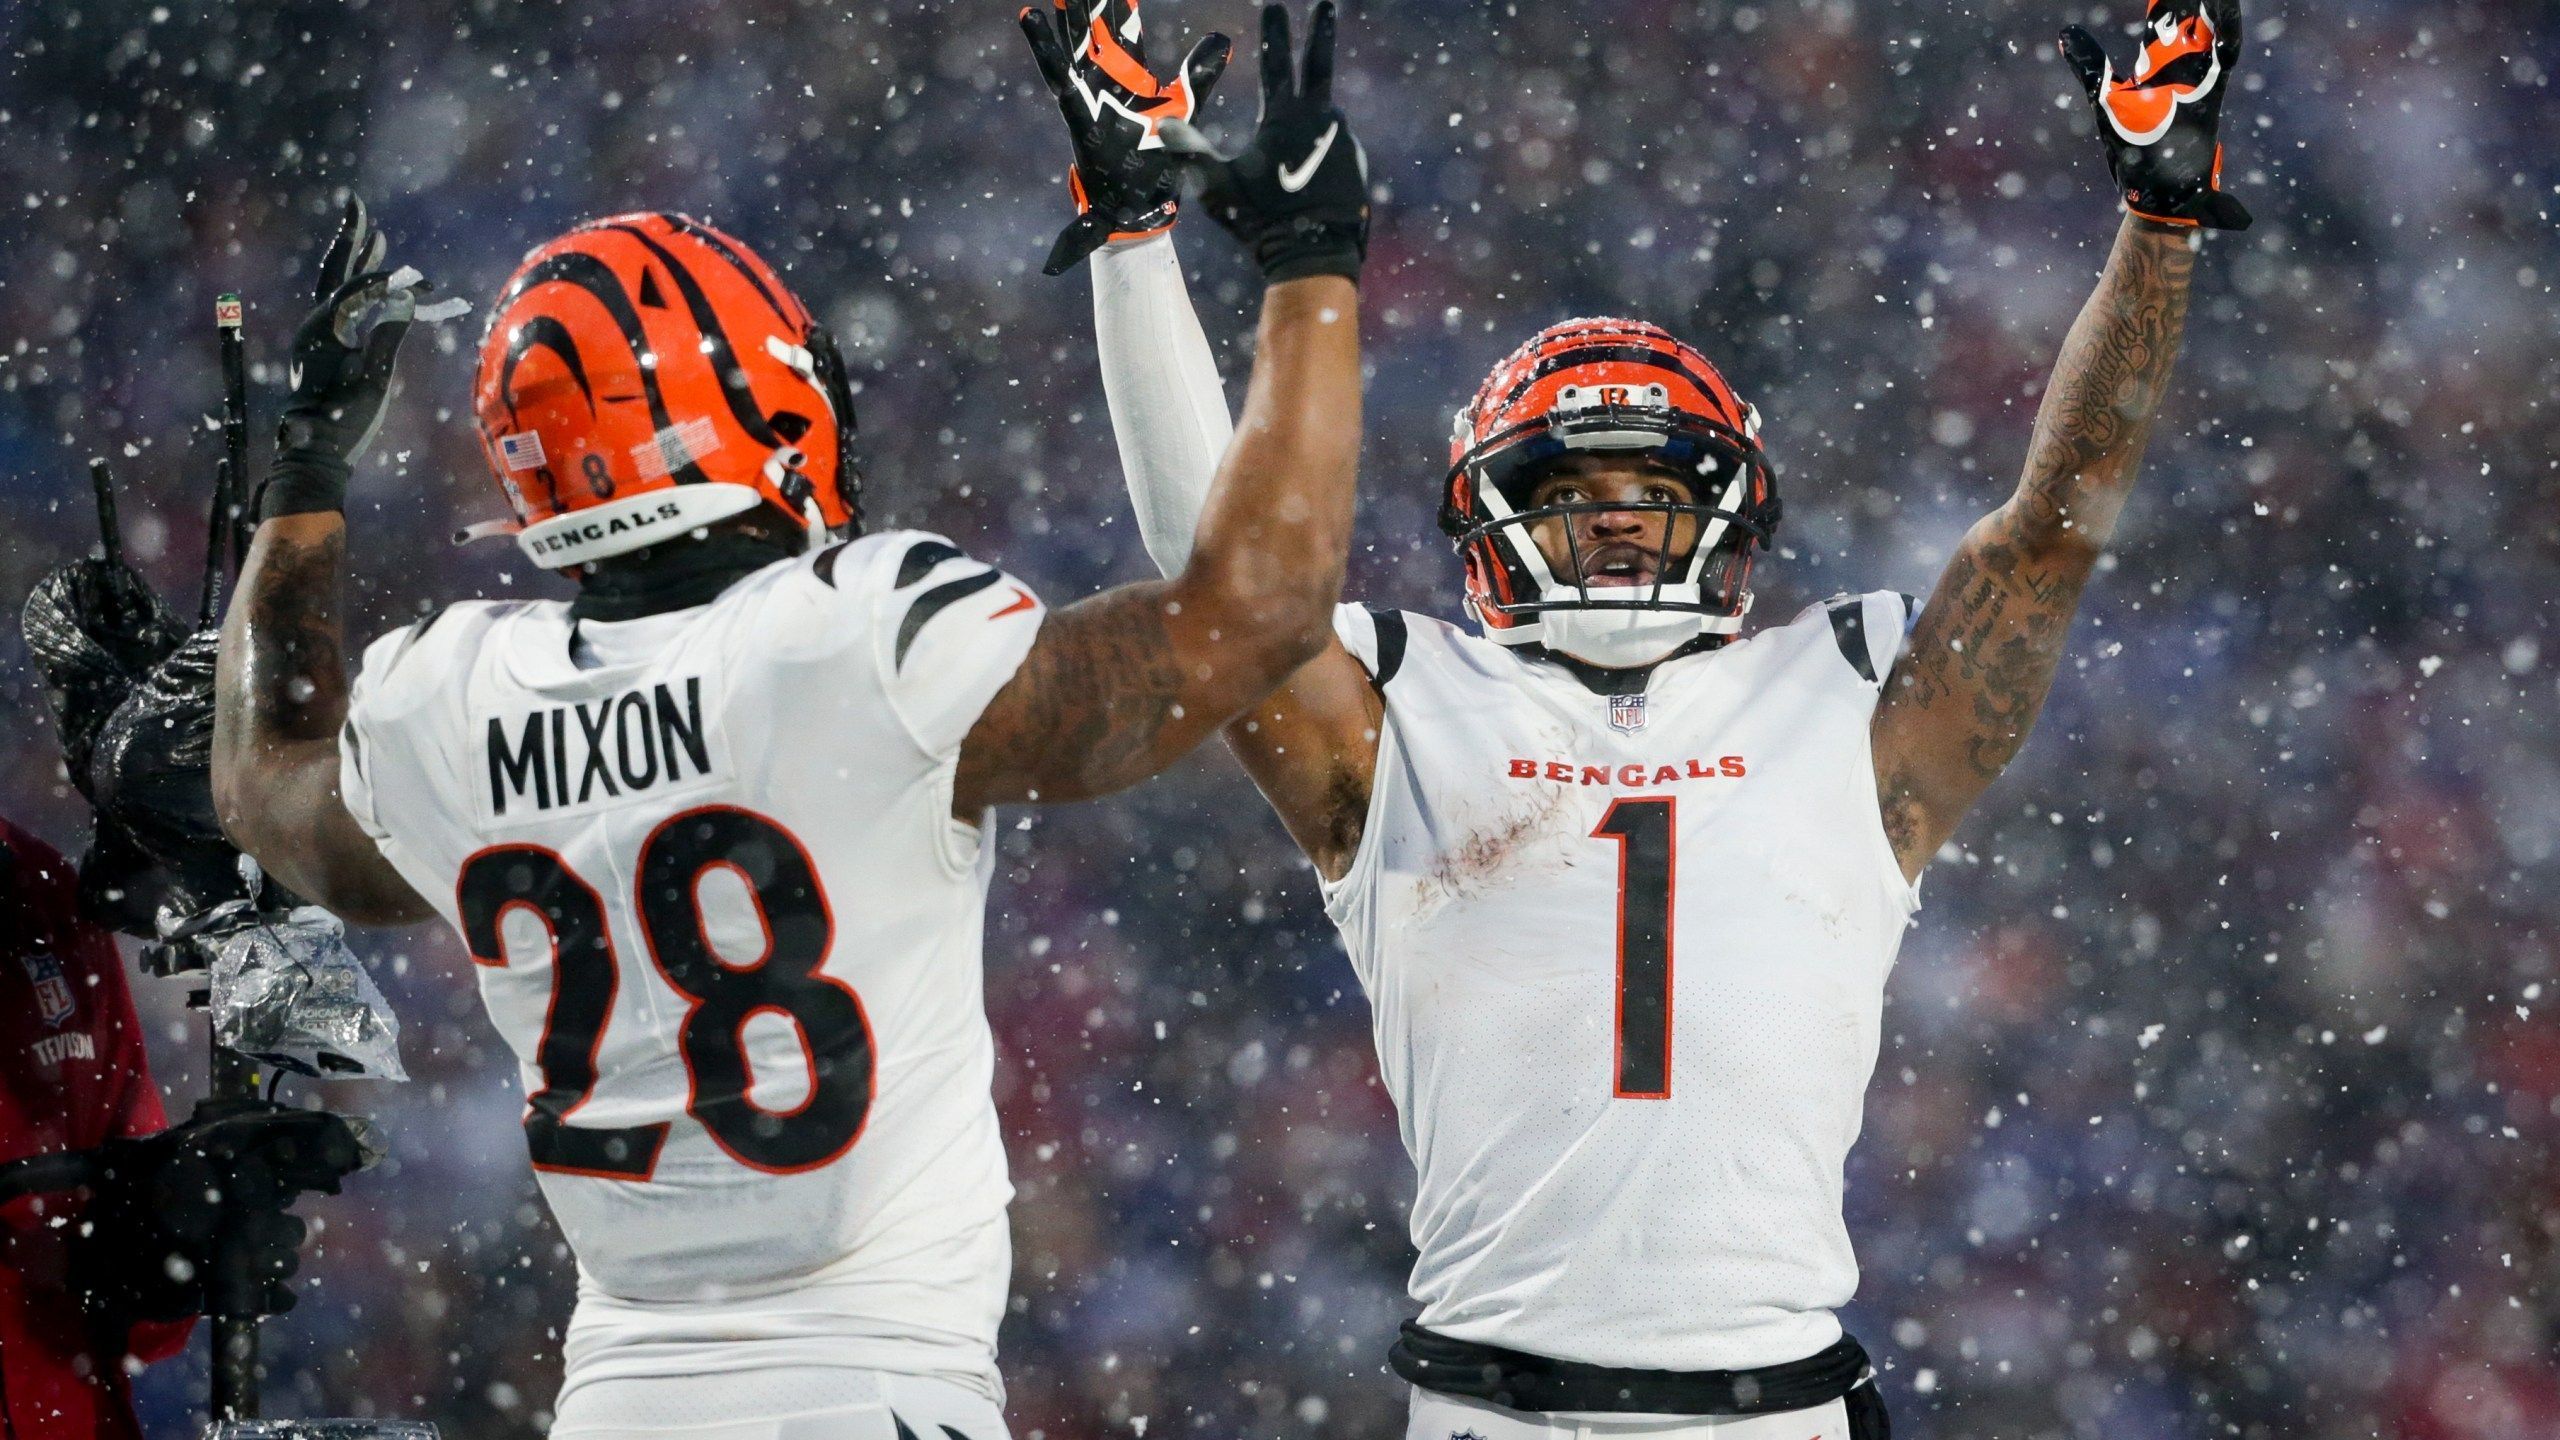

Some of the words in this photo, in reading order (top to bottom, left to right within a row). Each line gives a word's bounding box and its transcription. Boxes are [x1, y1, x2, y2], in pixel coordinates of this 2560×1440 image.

[531, 502, 682, 556] BENGALS
[487, 677, 712, 816] MIXON
[1613, 708, 1643, 726] NFL
[1507, 755, 1747, 787] BENGALS
[456, 804, 878, 1183] 28
[1588, 795, 1677, 1100] 1
